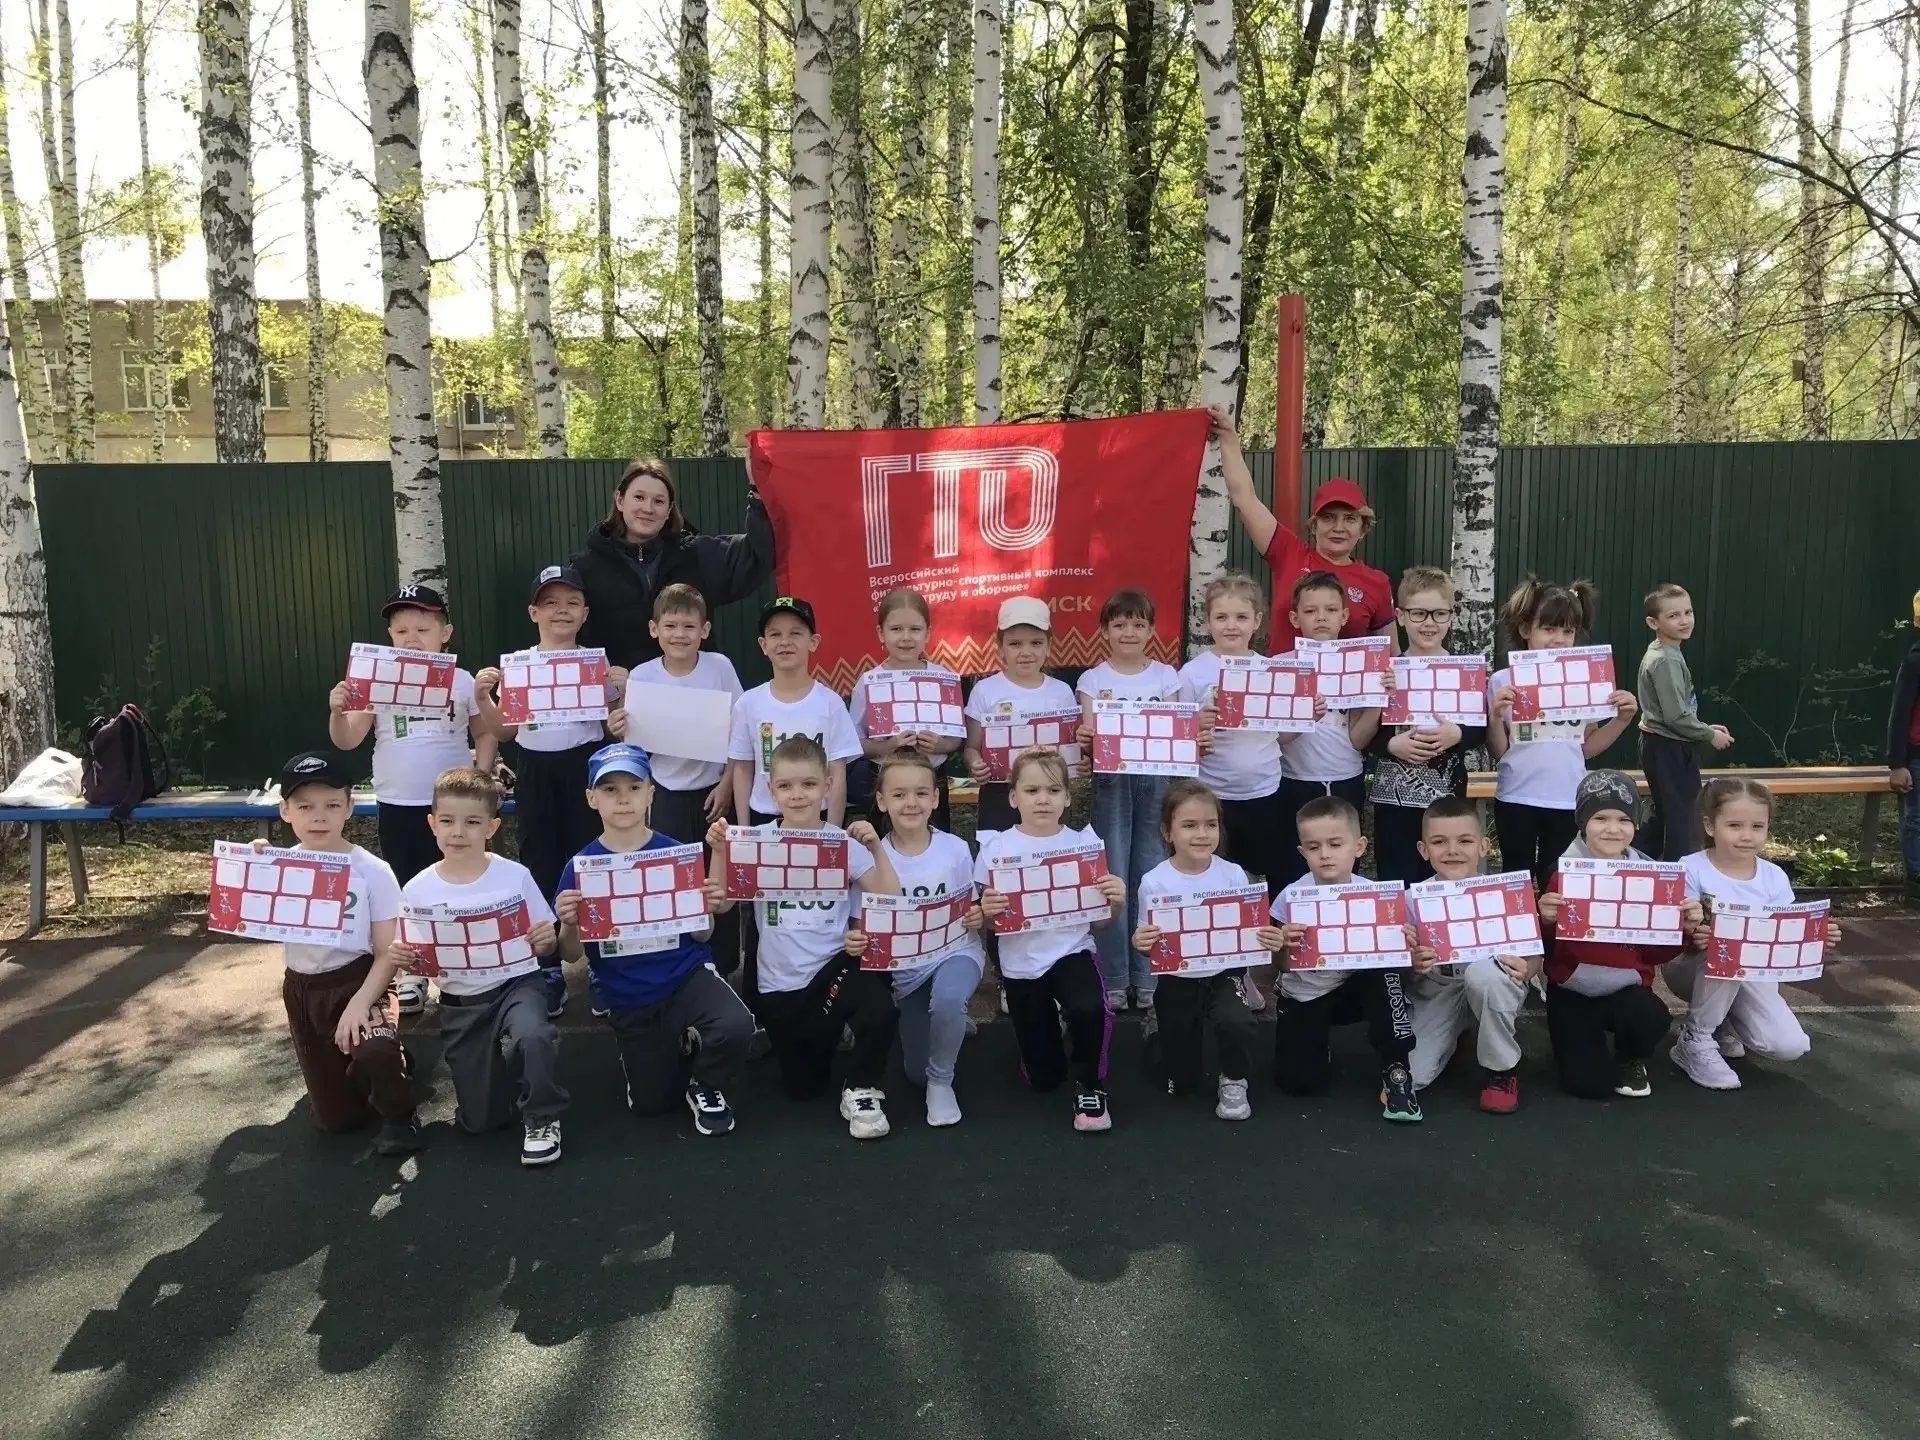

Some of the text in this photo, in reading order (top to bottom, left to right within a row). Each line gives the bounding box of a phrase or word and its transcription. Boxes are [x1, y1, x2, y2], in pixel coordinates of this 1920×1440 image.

[861, 446, 1059, 568] ГТО
[869, 564, 959, 587] Всероссийский
[1035, 567, 1094, 578] комплекс
[1020, 711, 1058, 719] РАСПИСАНИЕ
[772, 830, 817, 838] РАСПИСАНИЕ
[265, 850, 348, 863] РАСПИСАНИЕ УРОКОВ
[624, 851, 672, 862] РАСПИСАНИЕ
[673, 846, 700, 856] УРОКОВ
[1032, 843, 1102, 859] РАСПИСАНИЕ УРОКОВ
[1607, 862, 1653, 870] РАСПИСАНИЕ
[1330, 882, 1401, 893] РАСПИСАНИЕ УРОКОВ
[1455, 878, 1500, 888] РАСПИСАНИЕ
[1501, 873, 1527, 881] УРОКОВ
[1193, 889, 1238, 899] РАСПИСАНИЕ
[1239, 885, 1265, 894] УРОКОВ
[444, 903, 494, 916] РАСПИСАНИЕ
[495, 894, 522, 910] УРОКОВ
[1384, 973, 1412, 1039] RUSSIA
